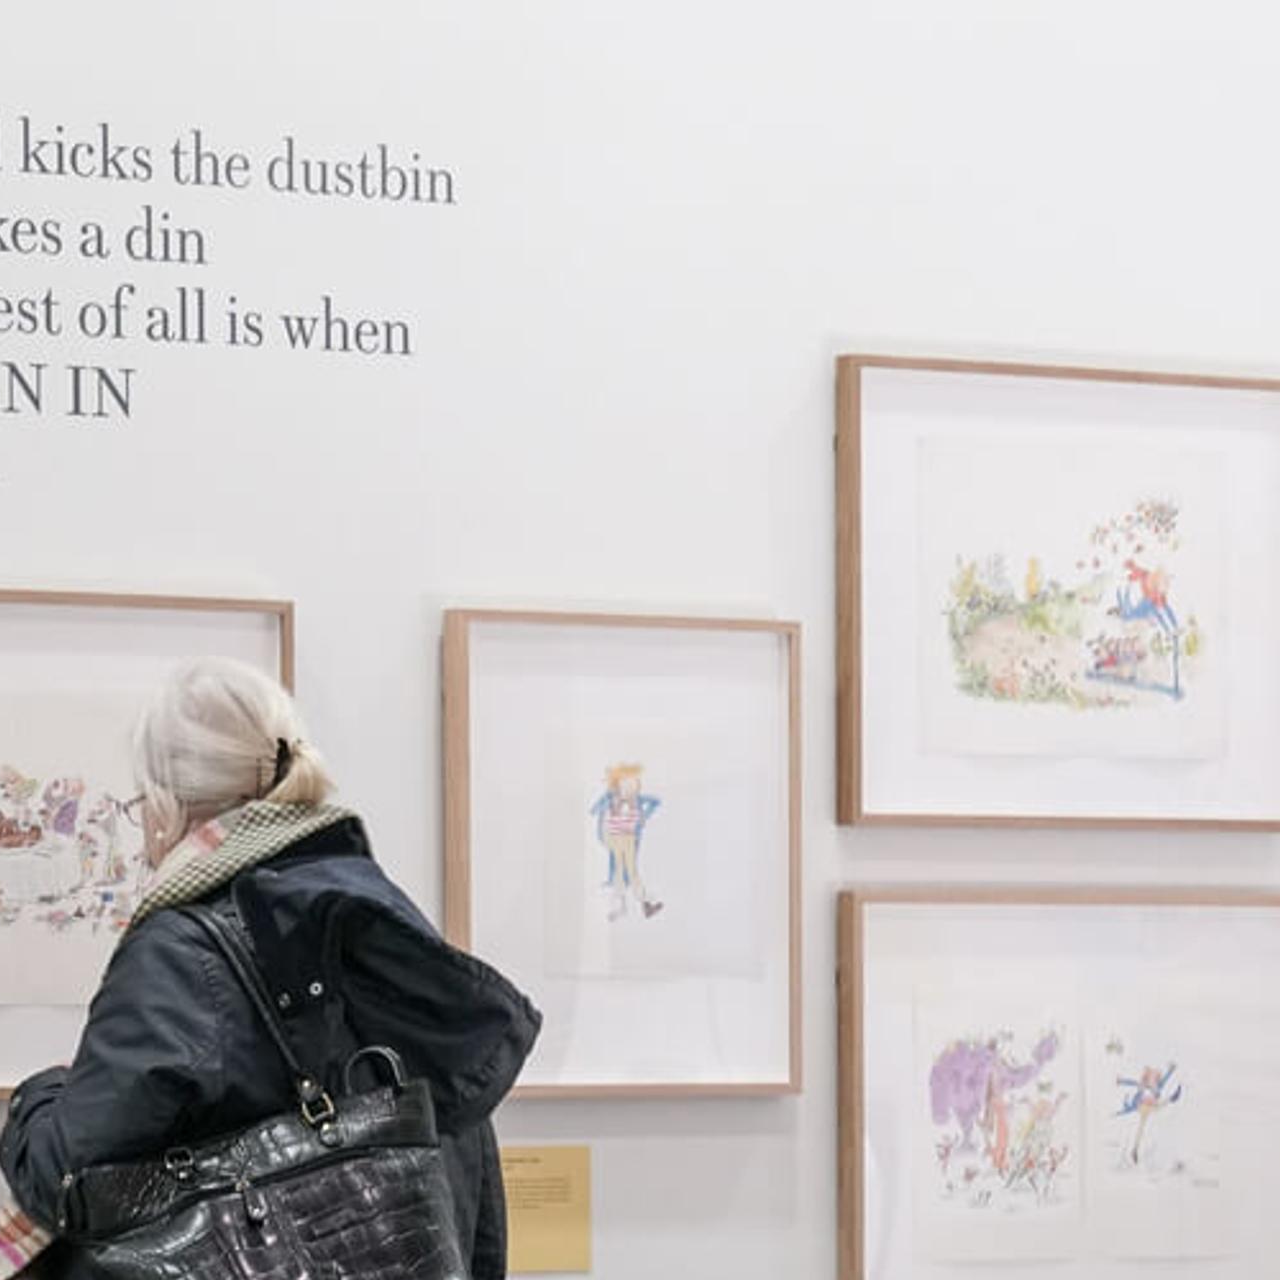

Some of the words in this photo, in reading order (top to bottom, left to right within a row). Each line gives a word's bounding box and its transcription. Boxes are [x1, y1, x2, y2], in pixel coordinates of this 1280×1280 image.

[19, 116, 153, 182] kicks
[170, 128, 250, 188] the
[267, 136, 456, 205] dustbin
[79, 222, 111, 259] a
[125, 205, 208, 265] din
[78, 283, 136, 339] of
[146, 287, 208, 344] all
[226, 296, 264, 347] is
[279, 295, 411, 356] when
[66, 365, 136, 418] IN
